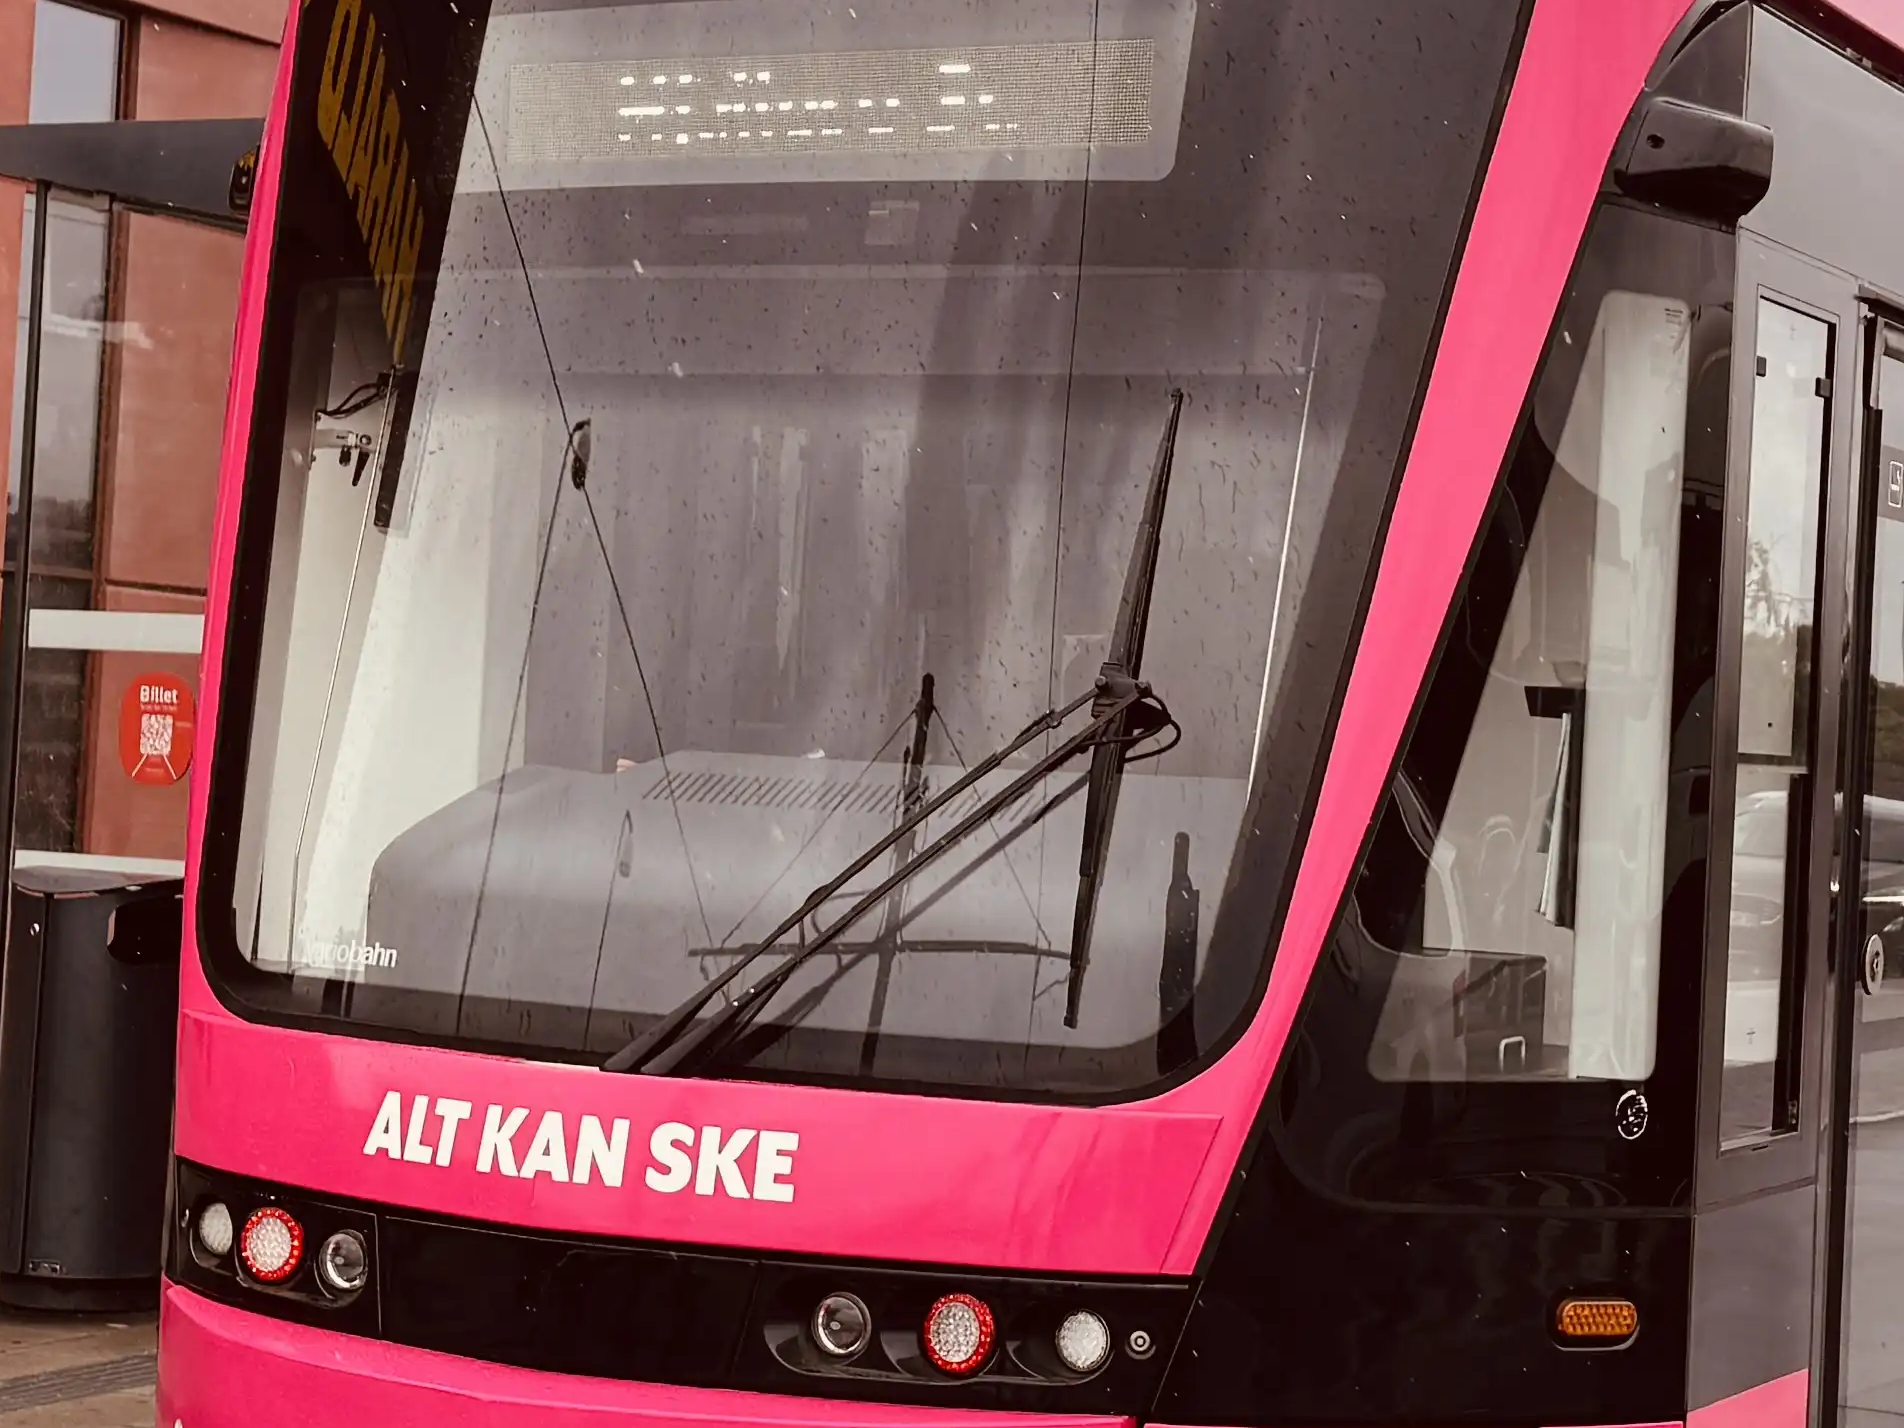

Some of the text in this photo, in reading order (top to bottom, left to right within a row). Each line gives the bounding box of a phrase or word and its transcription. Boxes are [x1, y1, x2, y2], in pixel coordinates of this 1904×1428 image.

[140, 685, 178, 704] Billet
[362, 1090, 801, 1203] ALT KAN SKE
